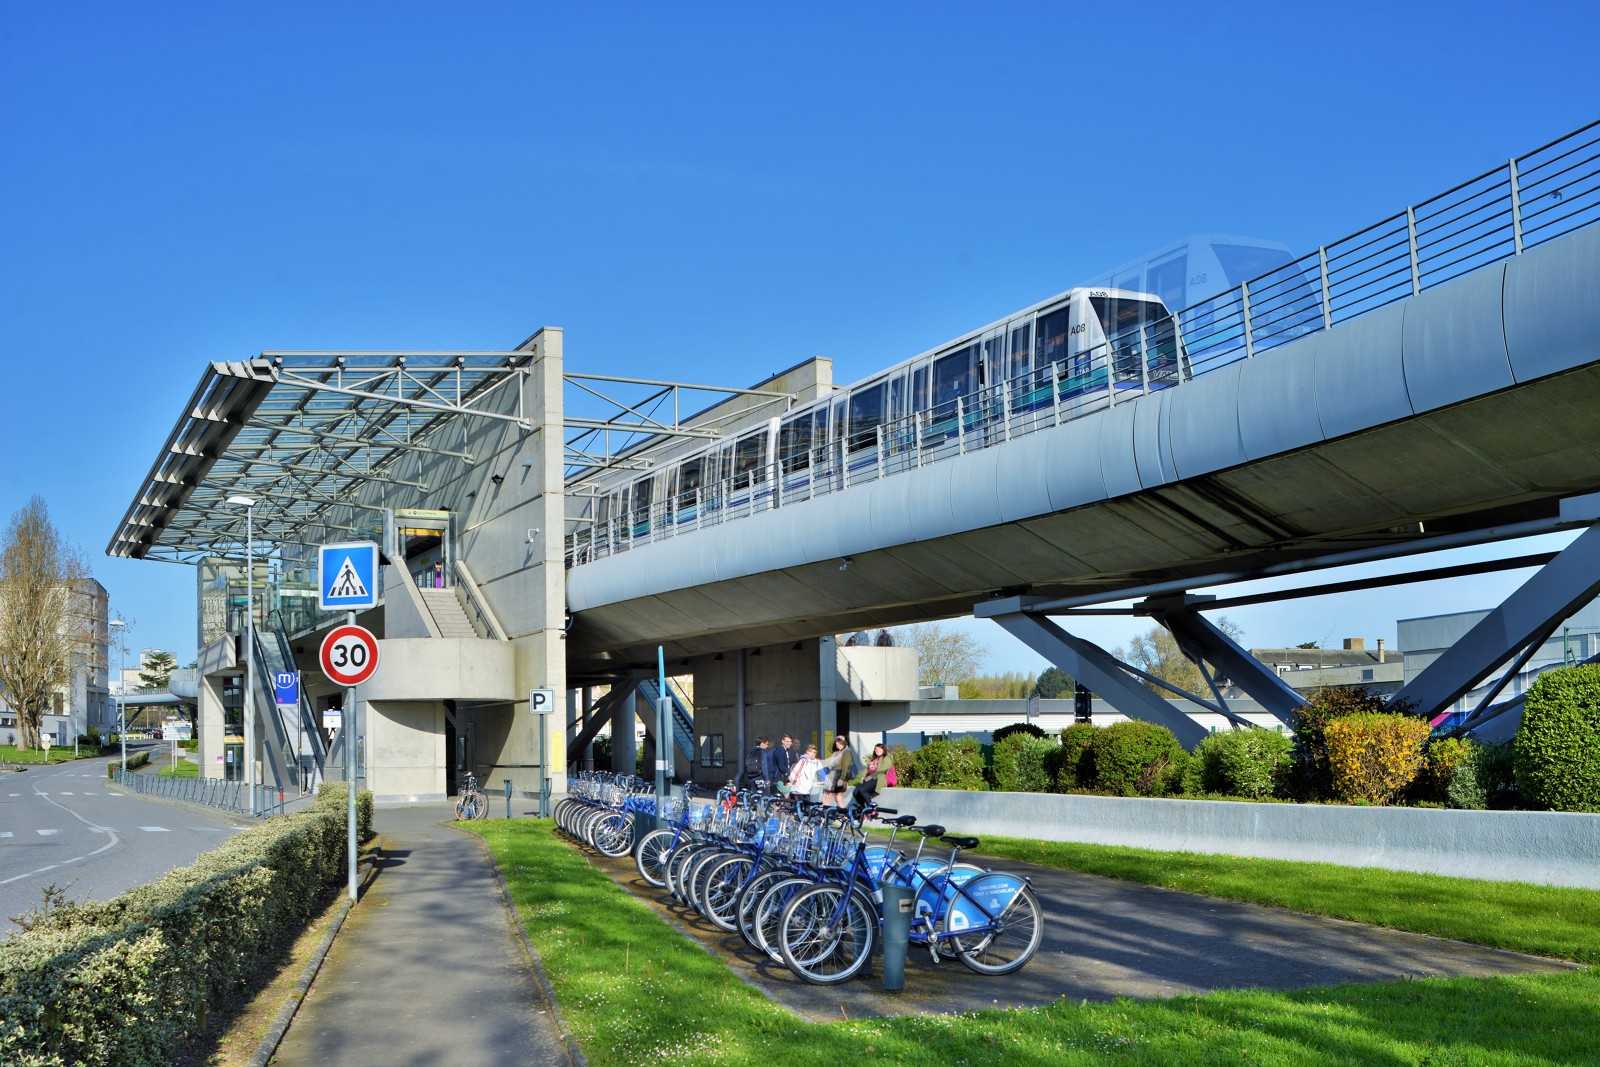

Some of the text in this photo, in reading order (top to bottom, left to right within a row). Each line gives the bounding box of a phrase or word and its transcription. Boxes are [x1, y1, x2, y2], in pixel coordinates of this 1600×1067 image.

[1189, 273, 1207, 287] A08
[1070, 323, 1086, 335] A08
[1076, 367, 1090, 377] STAR
[333, 643, 366, 667] 30
[533, 692, 546, 710] P
